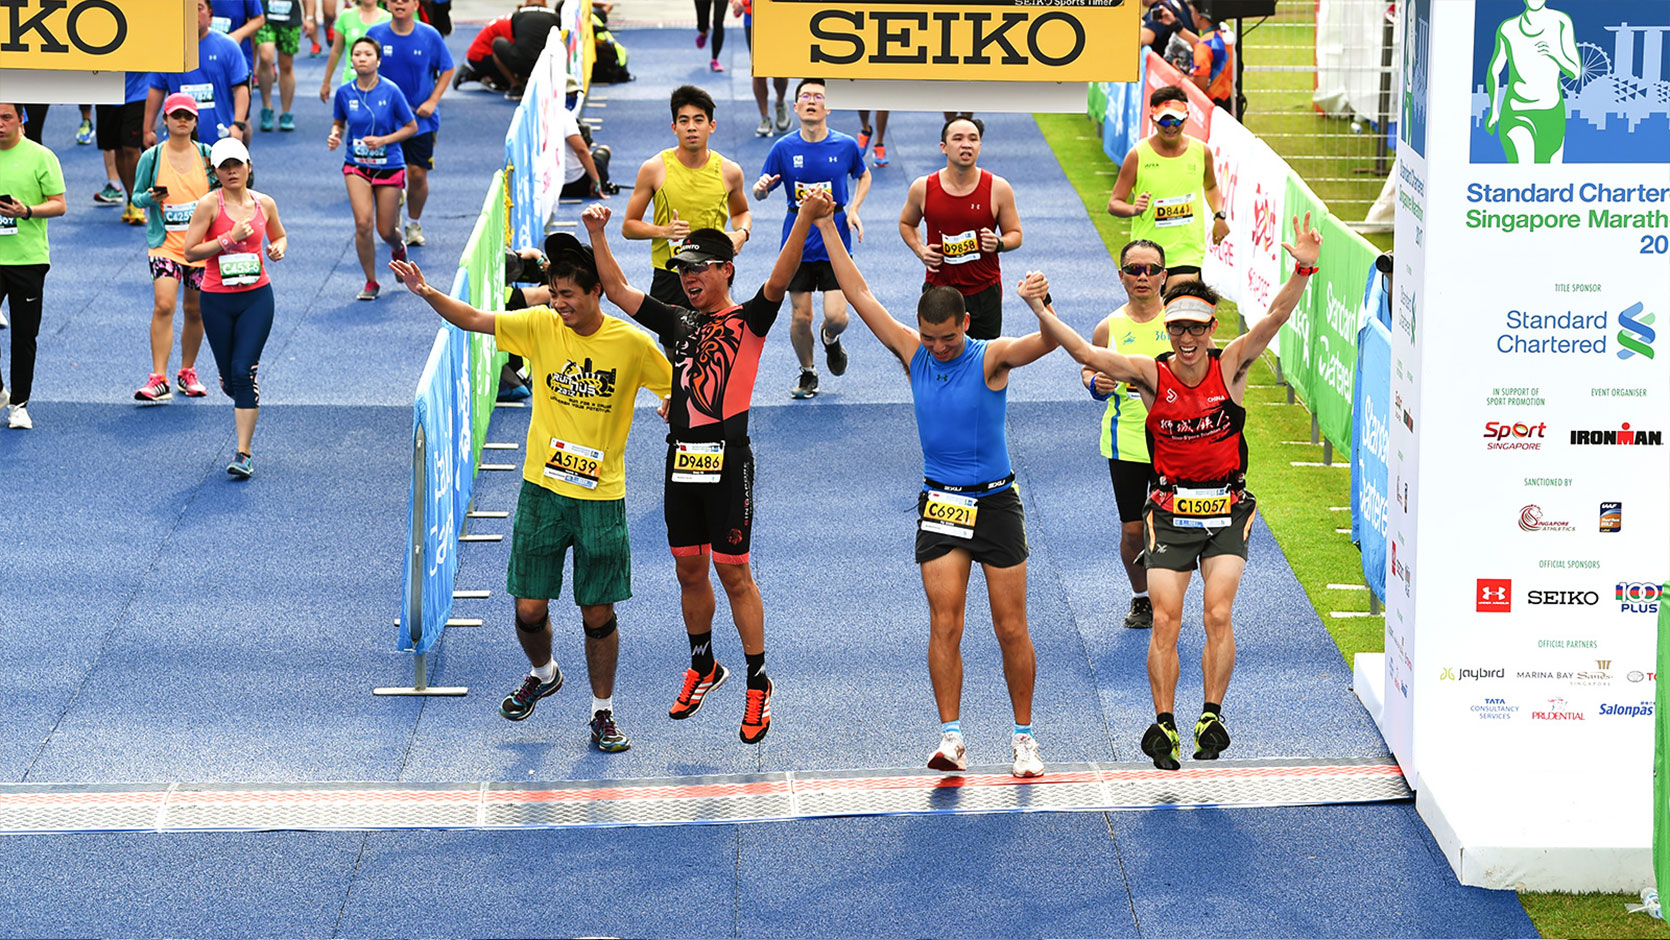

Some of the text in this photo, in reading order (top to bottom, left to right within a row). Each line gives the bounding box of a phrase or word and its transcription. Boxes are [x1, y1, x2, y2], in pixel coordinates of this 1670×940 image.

[809, 9, 1086, 67] SEIKO
[1466, 183, 1670, 203] Standard Charter
[1465, 209, 1670, 232] Singapore Marath
[944, 239, 976, 253] D9858
[1555, 284, 1601, 292] TITLE SPONSOR
[1326, 281, 1357, 346] Standard
[1506, 310, 1608, 329] Standard
[1496, 334, 1607, 353] Chartered
[1492, 388, 1539, 396] IN SUPPORT OF
[1591, 388, 1647, 397] EVENT ORGANISER
[1486, 398, 1545, 406] SPORT PROMOTION
[1483, 421, 1547, 441] Sport
[1570, 422, 1662, 445] IRONMAN
[1487, 442, 1541, 450] SINGAPORE
[551, 451, 597, 473] A5139
[678, 454, 720, 469] D9486
[1524, 478, 1573, 487] SANCTIONED BY
[928, 503, 970, 523] C6921
[1177, 499, 1226, 513] C15057
[1539, 560, 1600, 569] OFFICIAL SPONSORS
[1527, 590, 1600, 606] SEIKO
[1618, 582, 1660, 603] 100
[1621, 603, 1658, 613] PLUS
[1538, 640, 1598, 649] OFFICIAL PARTNERS
[1531, 711, 1586, 721] PRUDENTIAL
[1599, 703, 1653, 718] Salonpas
